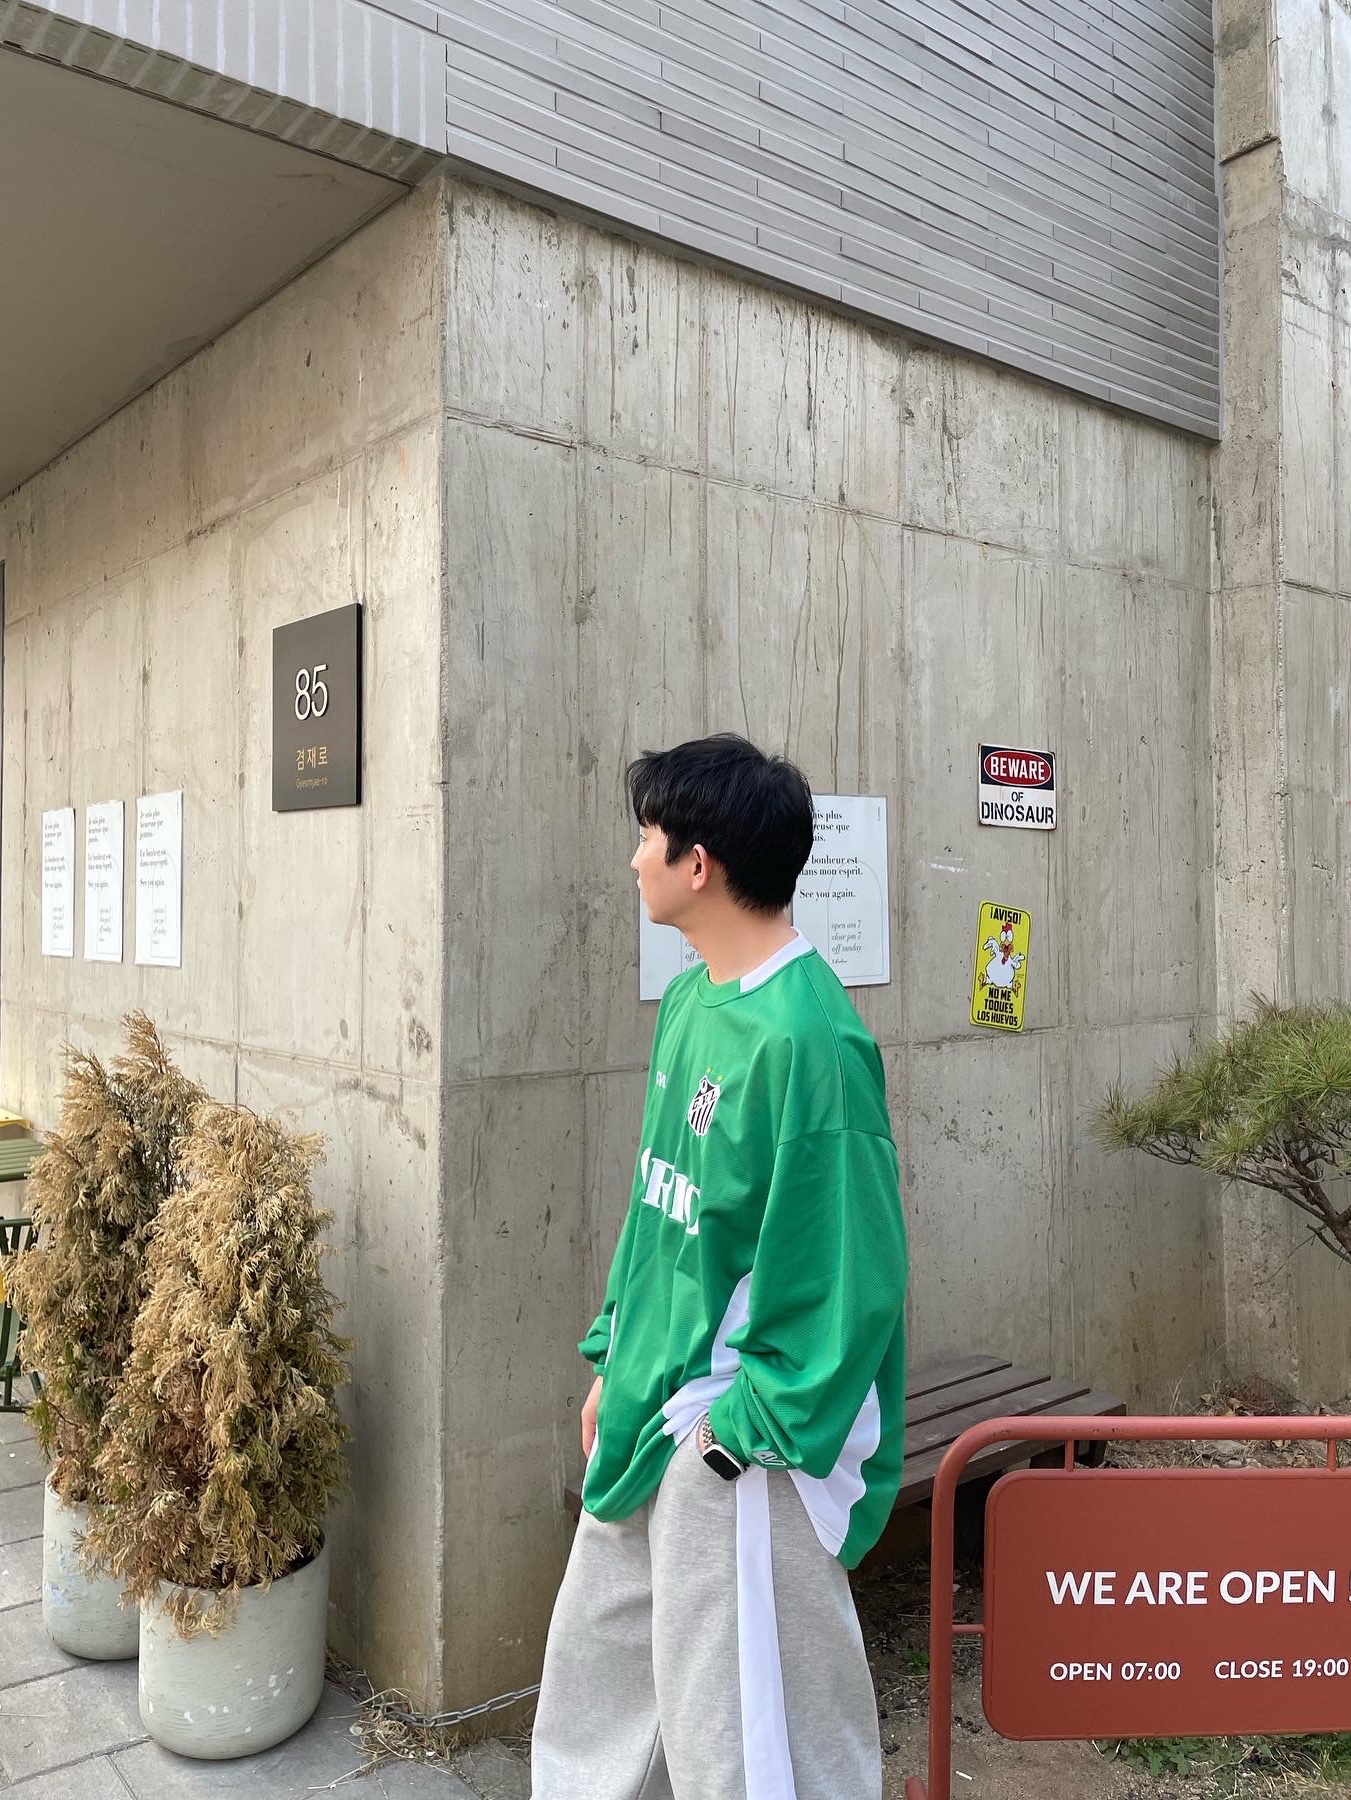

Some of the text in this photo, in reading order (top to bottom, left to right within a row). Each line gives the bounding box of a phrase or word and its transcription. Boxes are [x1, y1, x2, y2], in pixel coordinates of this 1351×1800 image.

[294, 663, 329, 721] 85
[295, 745, 329, 771] 겸재로
[990, 755, 1046, 781] BEWARE
[1011, 791, 1024, 803] OF
[825, 809, 843, 823] plus
[981, 801, 1055, 824] DINOSAUR
[835, 823, 851, 834] que
[811, 854, 846, 865] bonheur
[847, 855, 859, 865] est
[819, 868, 837, 876] mon
[838, 865, 863, 879] esprit.
[799, 887, 856, 901] See you again.
[831, 922, 846, 932] open
[857, 919, 862, 929] 7
[857, 931, 862, 940] 7
[831, 943, 843, 955] off
[988, 986, 1012, 1002] NO ME
[984, 998, 1014, 1014] TOQUES
[977, 1010, 1018, 1027] LOS HUEVOS
[1045, 1571, 1117, 1605] WE
[1124, 1571, 1209, 1605] ARE
[1219, 1570, 1336, 1605] OPEN
[1050, 1658, 1349, 1681] OPEN 07:00 CLOSE 19:00
